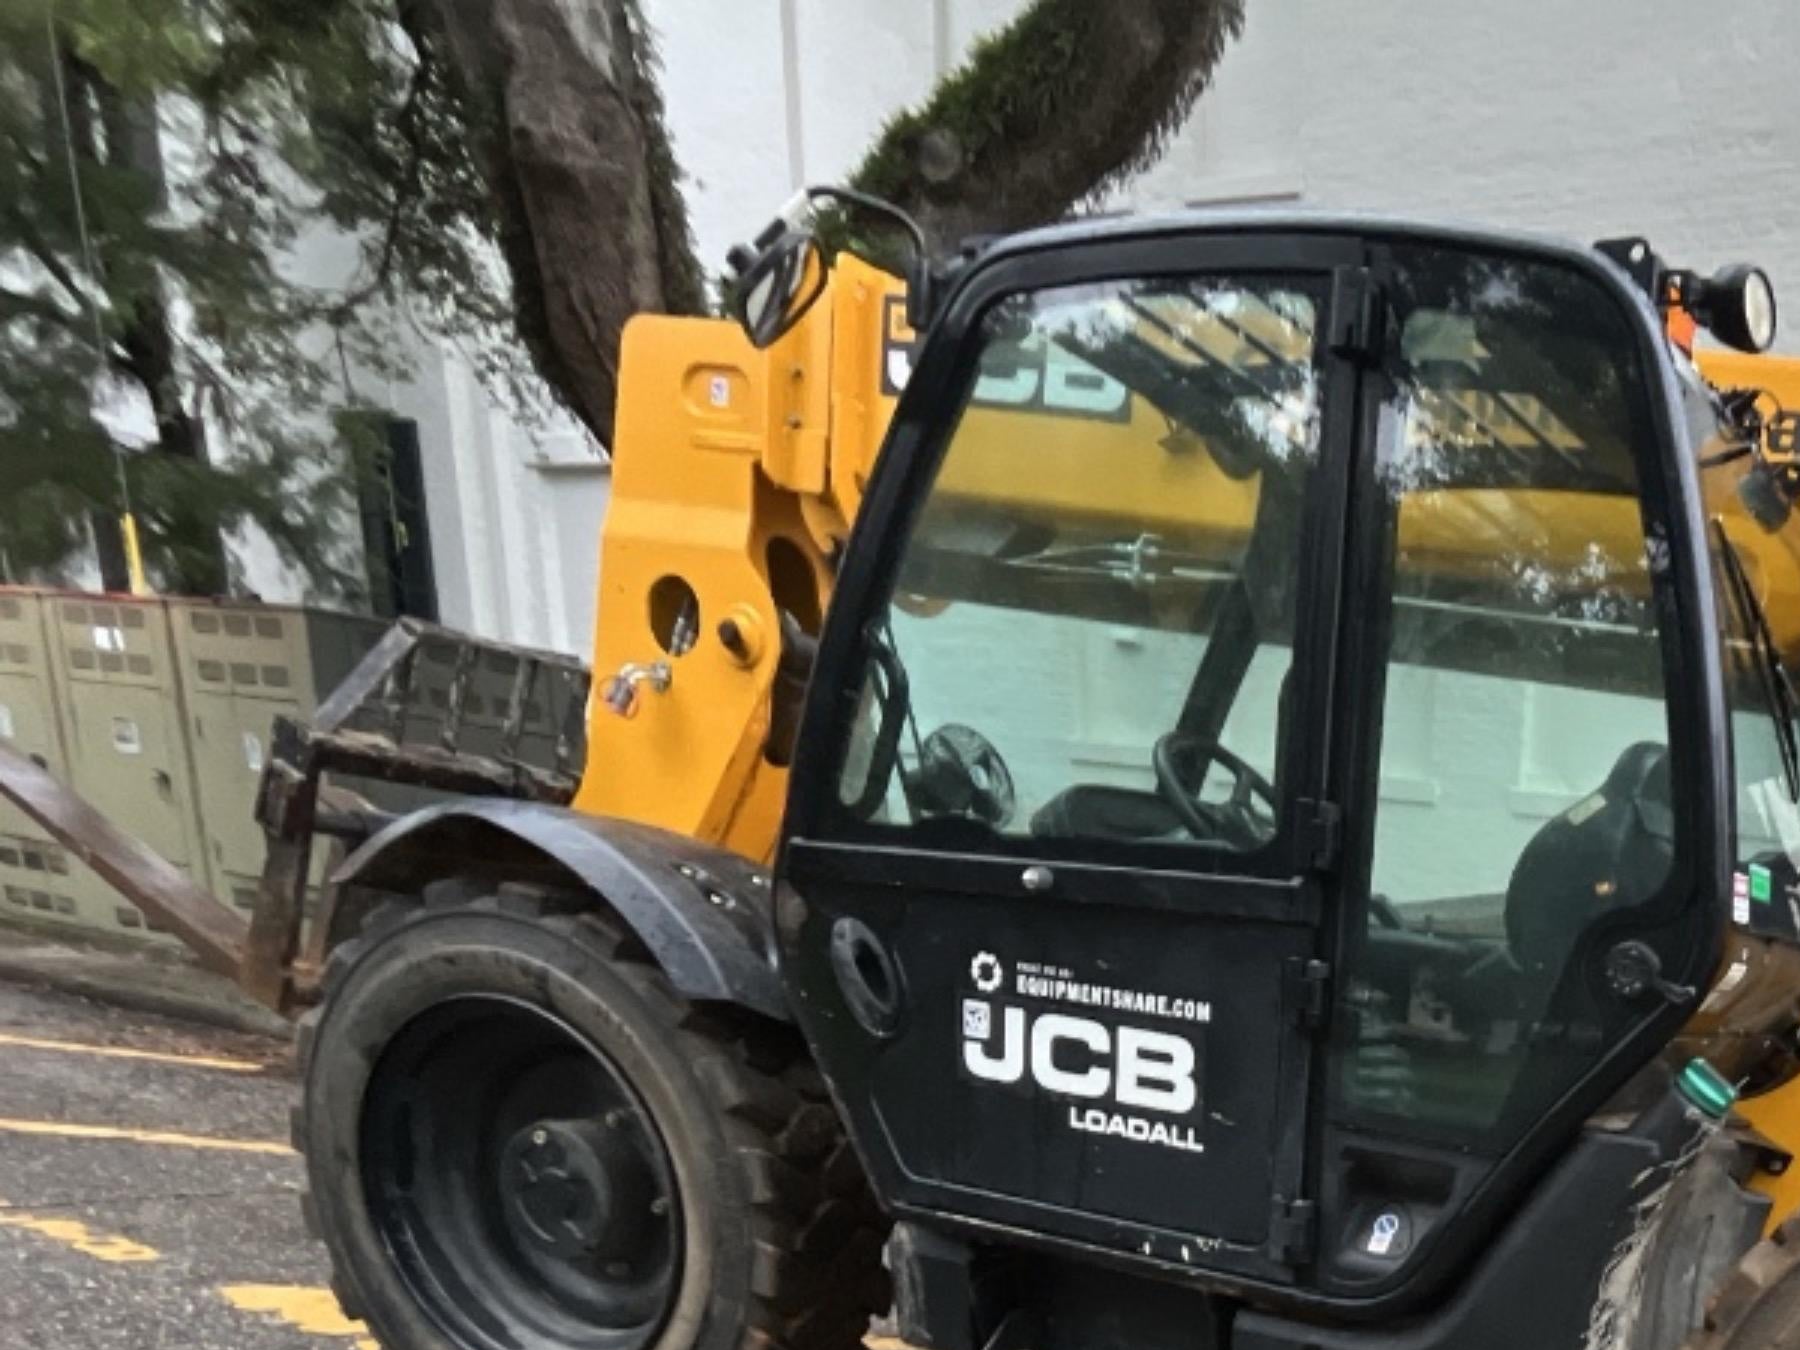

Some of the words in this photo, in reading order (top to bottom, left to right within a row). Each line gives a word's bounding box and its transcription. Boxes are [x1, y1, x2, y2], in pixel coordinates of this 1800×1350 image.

[1015, 974, 1212, 1022] EQUIPMENTSHARE.COM
[962, 1005, 1197, 1114] JCB
[1068, 1105, 1205, 1153] LOADALL
